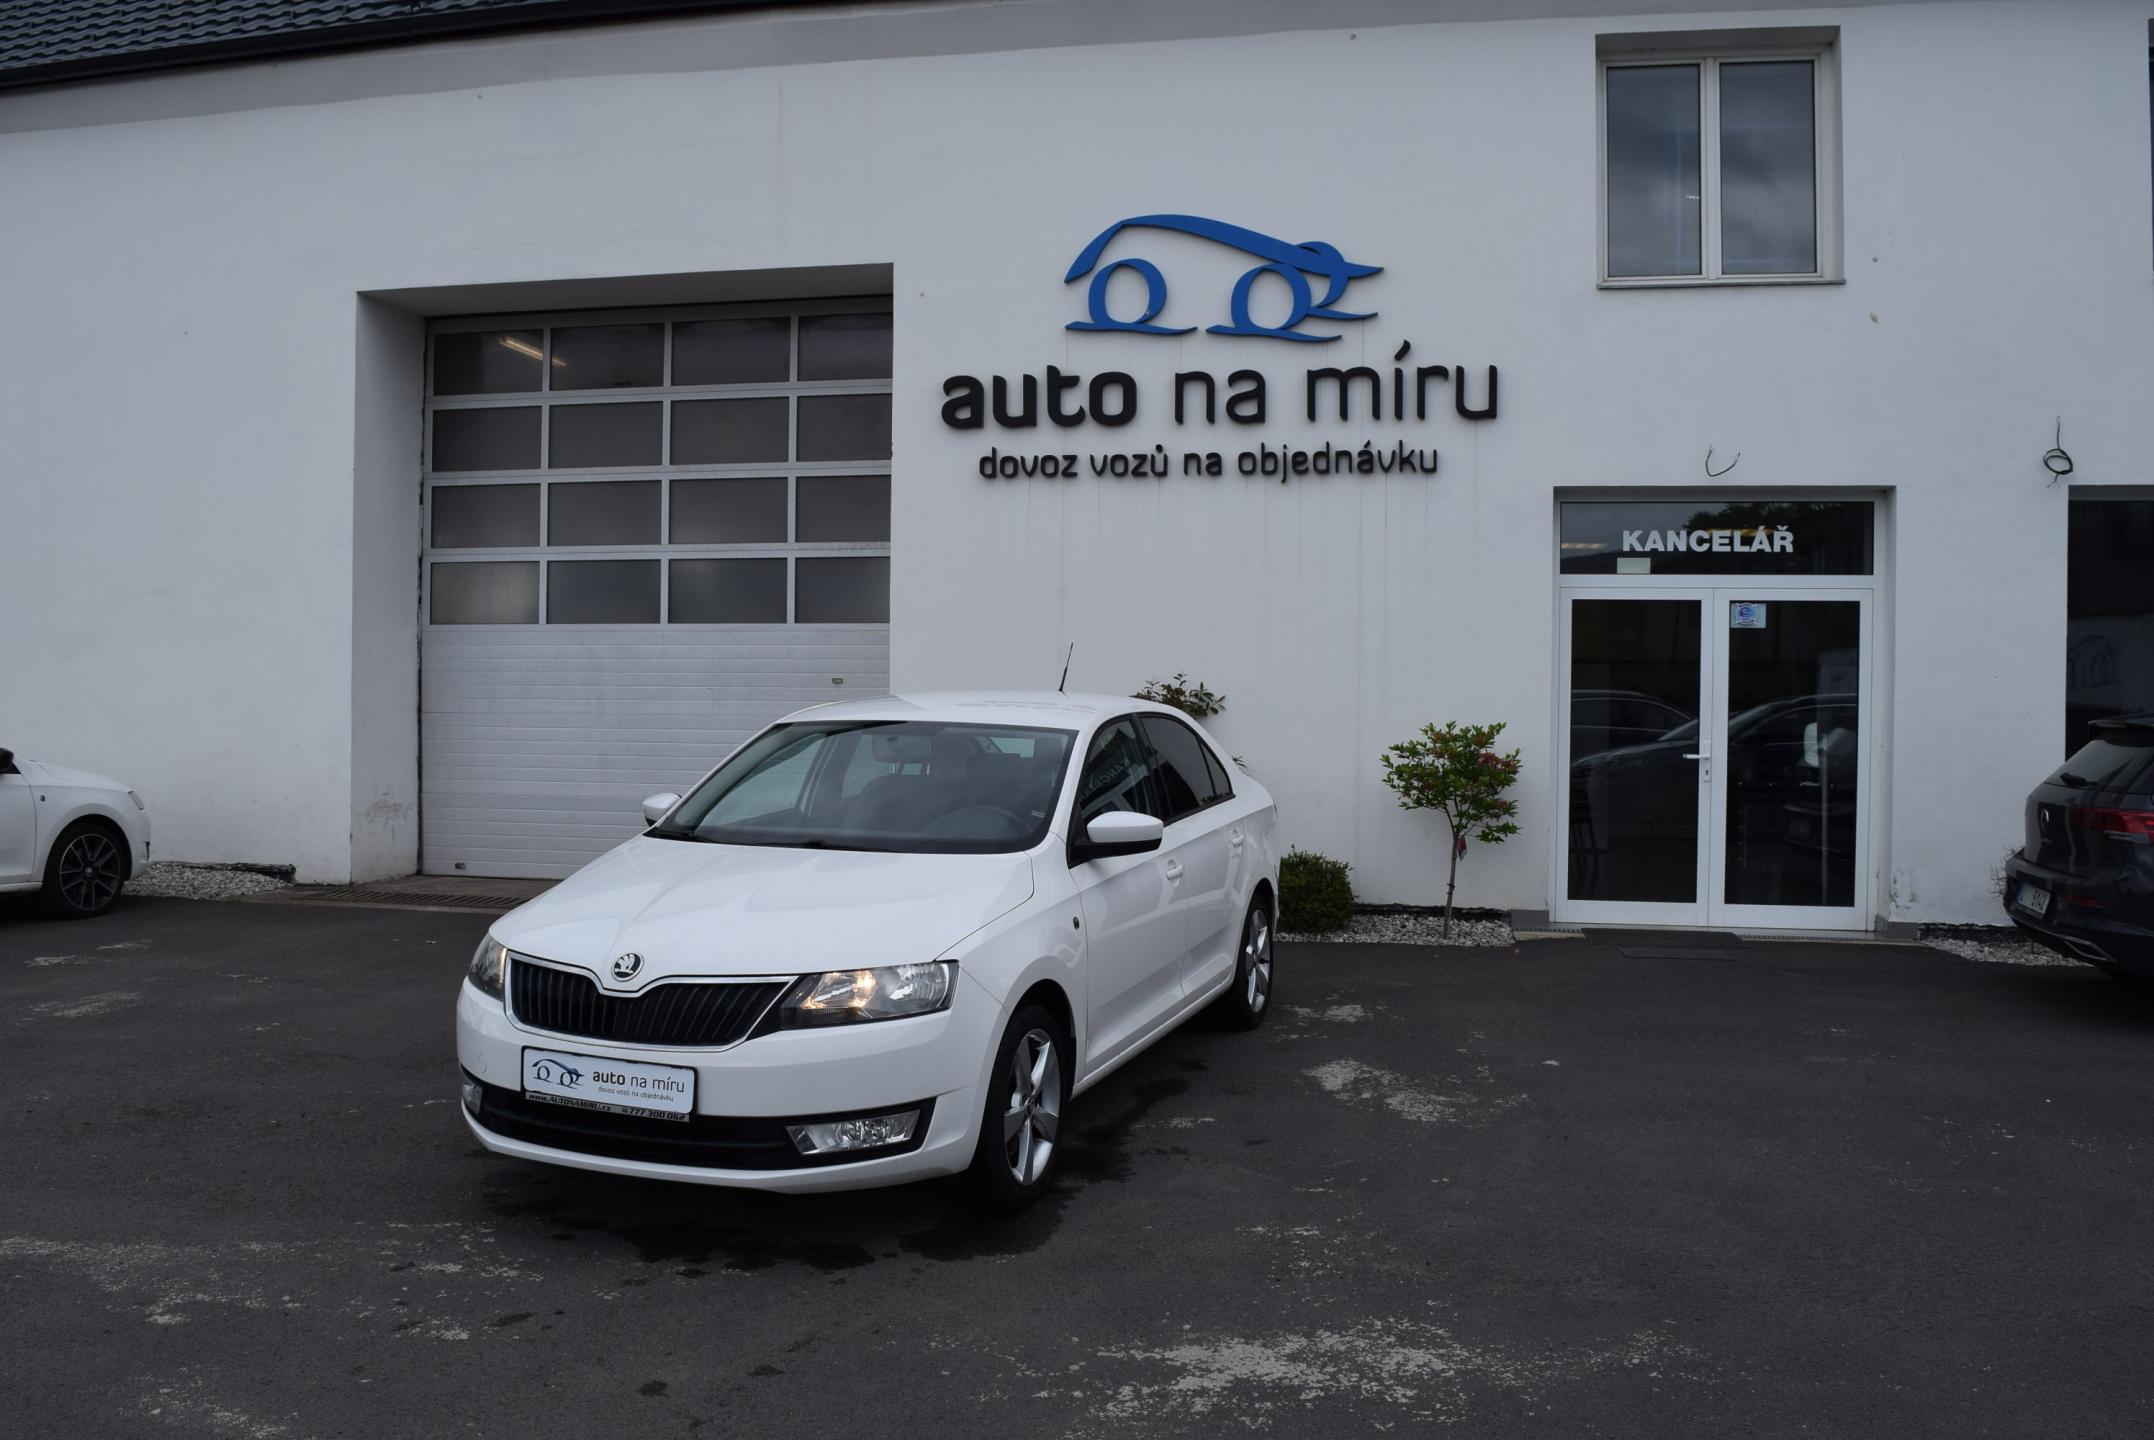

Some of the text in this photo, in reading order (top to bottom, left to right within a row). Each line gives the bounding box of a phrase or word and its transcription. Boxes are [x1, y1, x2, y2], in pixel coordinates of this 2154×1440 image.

[941, 339, 1498, 429] auto na míru
[979, 440, 1438, 483] dovoz vozů na objednávku
[1622, 525, 1794, 553] KANCELÁŘ
[592, 1070, 685, 1093] auto na míru
[640, 1092, 674, 1102] objednávku
